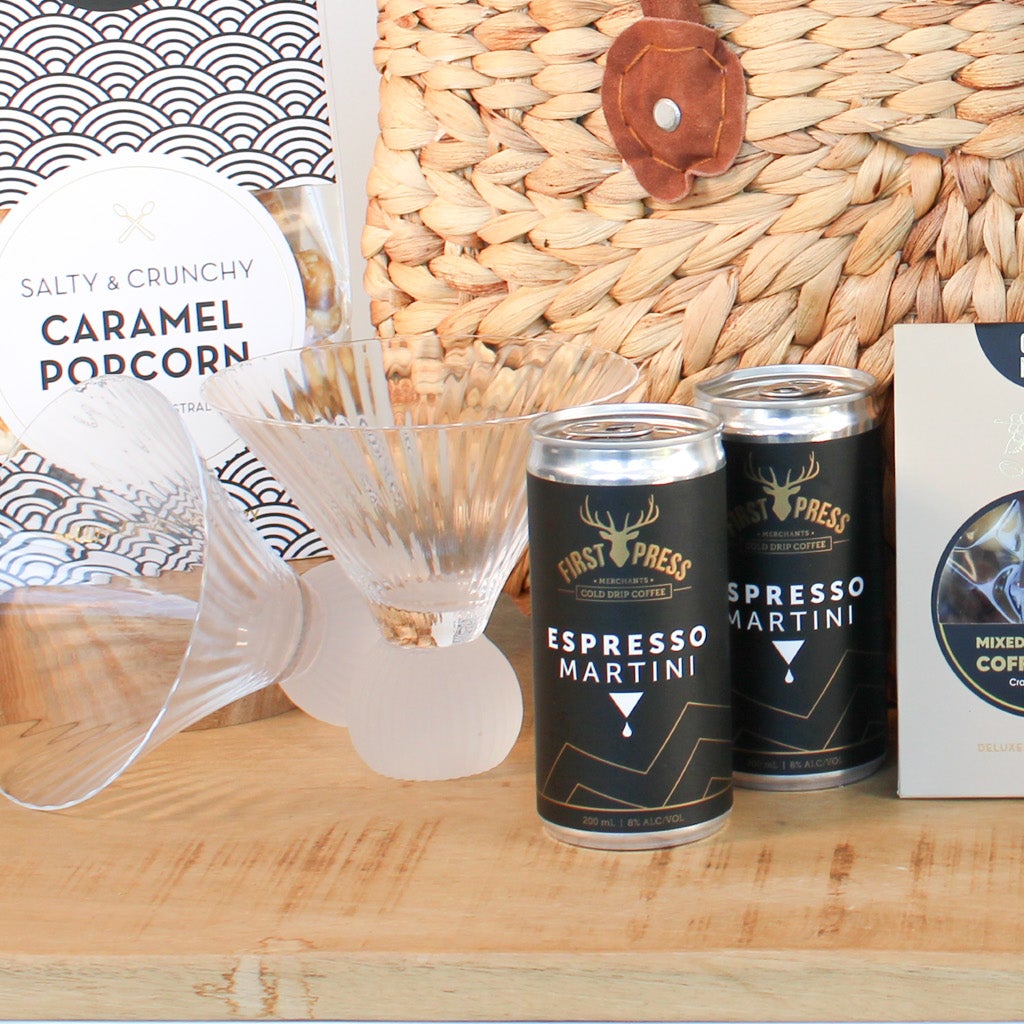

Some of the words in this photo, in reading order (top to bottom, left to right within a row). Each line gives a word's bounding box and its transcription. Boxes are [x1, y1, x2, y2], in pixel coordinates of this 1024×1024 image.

[21, 273, 98, 298] SALTY
[107, 275, 120, 291] &
[128, 259, 254, 289] CRUNCHY
[41, 300, 243, 345] CARAMEL
[40, 341, 249, 391] POPCORN
[794, 496, 851, 534] PRESS
[770, 541, 792, 551] DRIP
[793, 540, 827, 551] COFFEE
[557, 543, 606, 584] FIRST
[631, 542, 692, 581] PRESS
[581, 589, 606, 599] COLD
[607, 590, 630, 599] DRIP
[631, 588, 667, 599] COFFEE
[599, 577, 649, 585] MERCHANTS
[728, 576, 864, 606] SPRESSO
[729, 604, 853, 632] MARTINI
[547, 625, 707, 656] ESPRESSO
[560, 655, 695, 684] MARTINI
[977, 743, 1023, 753] DELUXE
[582, 815, 598, 825] 200
[601, 819, 615, 827] mL
[627, 817, 640, 826] 8%
[643, 814, 684, 826] ALC/VOL
